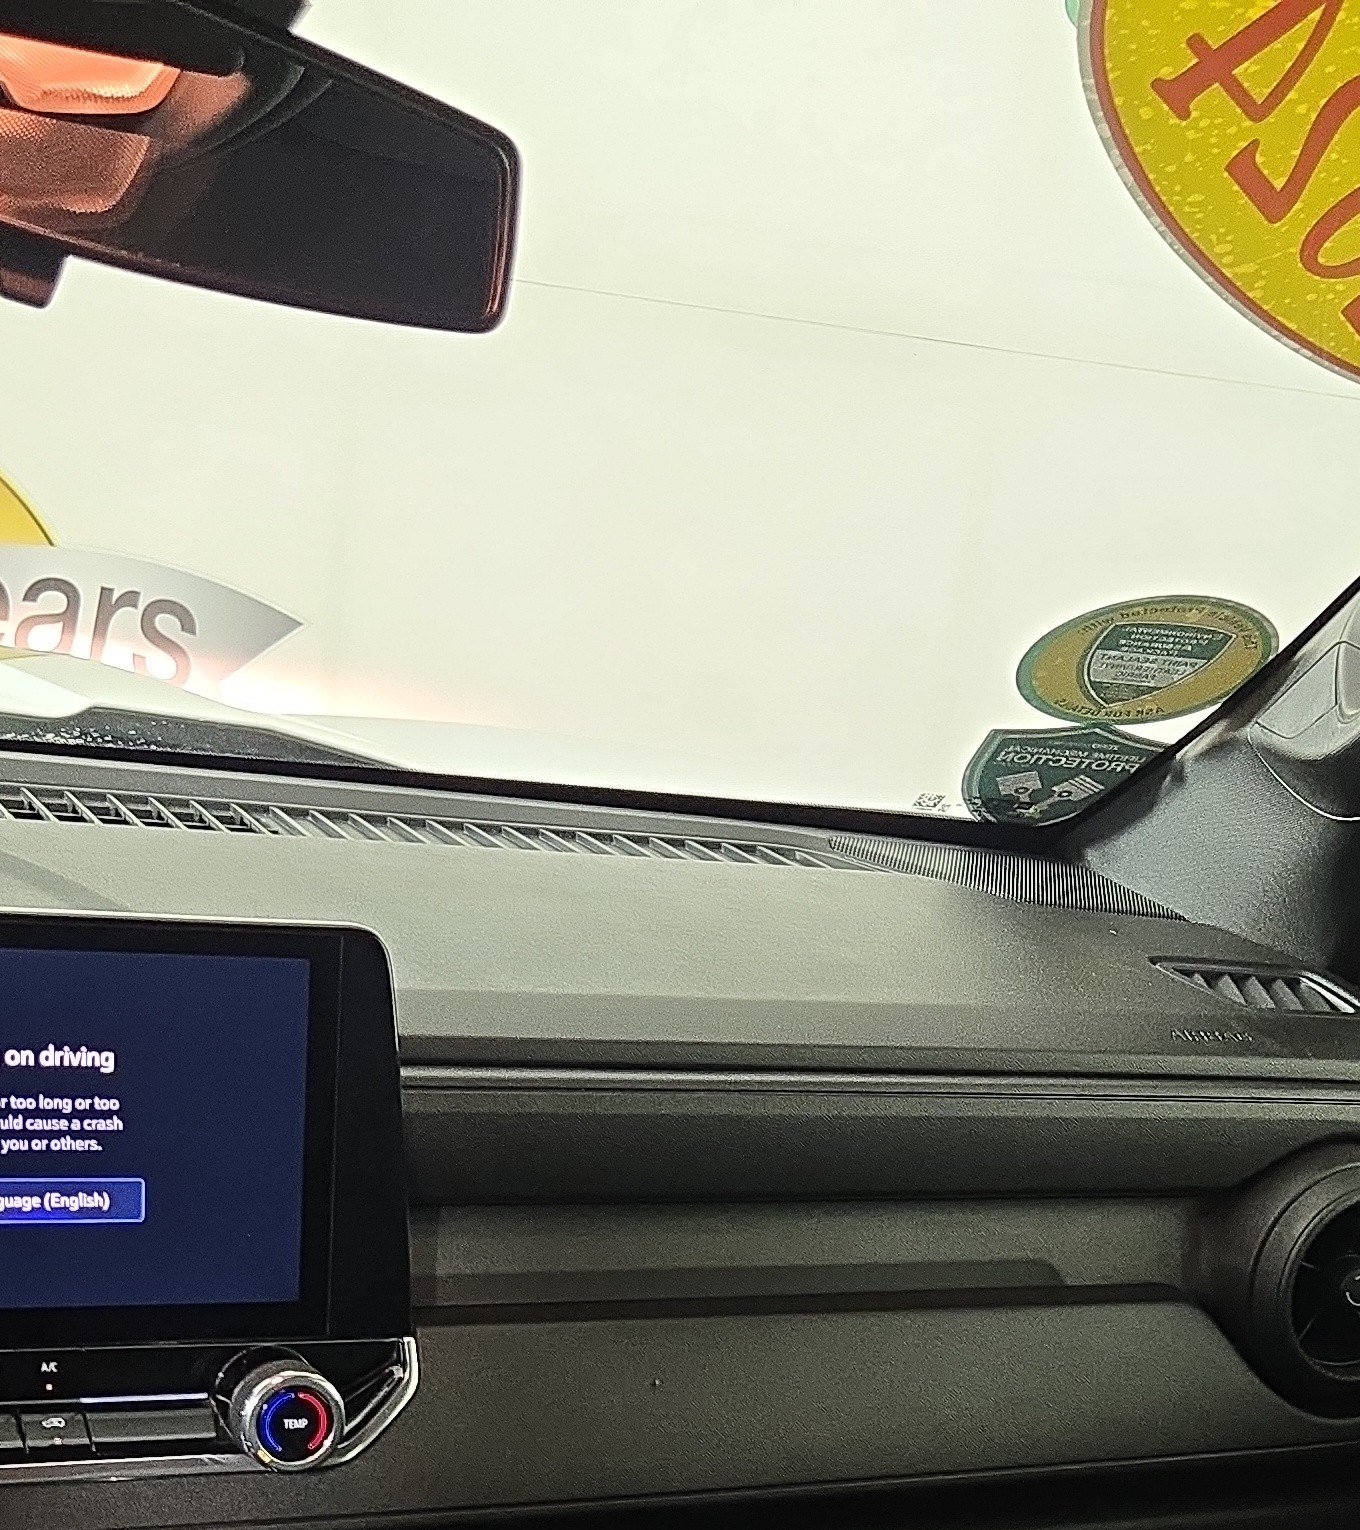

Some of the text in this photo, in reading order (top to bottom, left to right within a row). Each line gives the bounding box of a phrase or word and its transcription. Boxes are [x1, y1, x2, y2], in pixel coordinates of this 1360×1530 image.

[4, 1050, 35, 1067] on
[39, 1045, 115, 1073] driving
[10, 1097, 37, 1110] too
[38, 1094, 72, 1113] long
[74, 1099, 93, 1111] or
[93, 1097, 120, 1111] too
[25, 1118, 69, 1131] cause
[70, 1119, 81, 1131] a
[83, 1115, 124, 1132] crash
[0, 1138, 29, 1155] you
[31, 1138, 49, 1151] or
[49, 1135, 103, 1152] others.
[43, 1191, 111, 1212] (English)
[41, 1361, 58, 1373] A/C
[282, 1417, 309, 1430] TEMP
